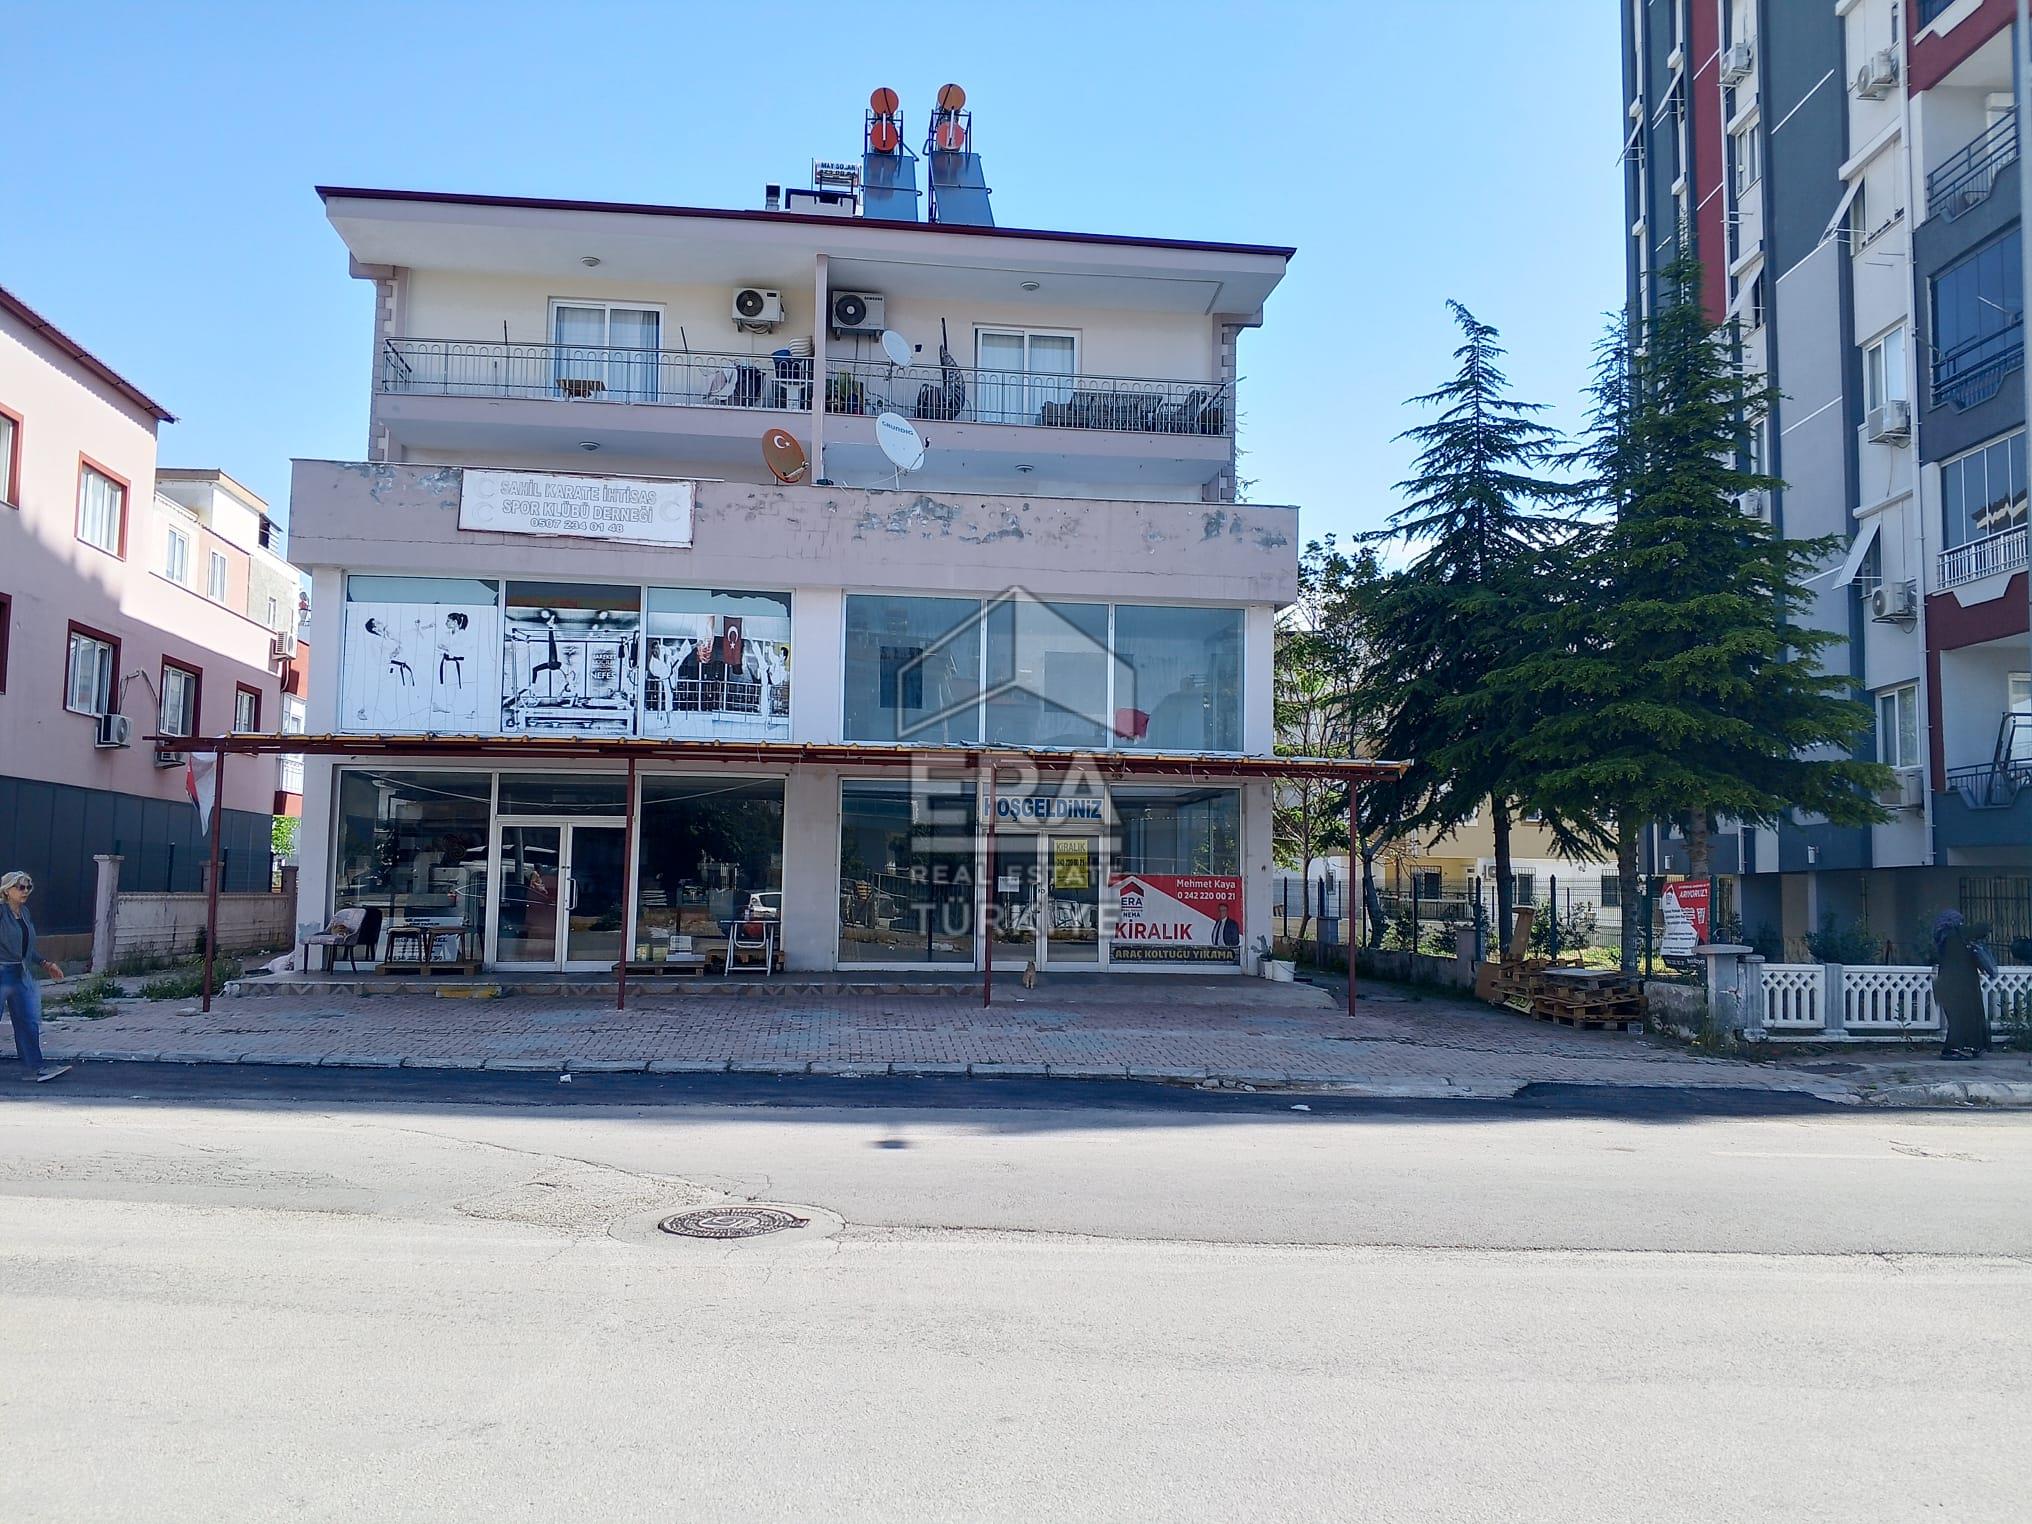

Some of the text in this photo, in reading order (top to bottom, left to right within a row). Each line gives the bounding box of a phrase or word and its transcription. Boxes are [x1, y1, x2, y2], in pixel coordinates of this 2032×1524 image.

[882, 421, 914, 435] GRUNDIG
[500, 480, 656, 505] SAHİL KARATE İHTİSAS
[503, 499, 654, 523] SPOR KLÜBÜ DERNEĞİ
[530, 518, 561, 528] 0507
[564, 520, 587, 530] 234
[589, 522, 604, 532] 01
[1176, 879, 1236, 890] Mehmet Kaya
[1121, 897, 1143, 906] ERA
[1177, 892, 1236, 900] 0 242 220 00 21
[1115, 919, 1193, 940] KİRALIK
[1115, 949, 1143, 960] ARAÇ
[1193, 950, 1234, 959] YIKAMA
